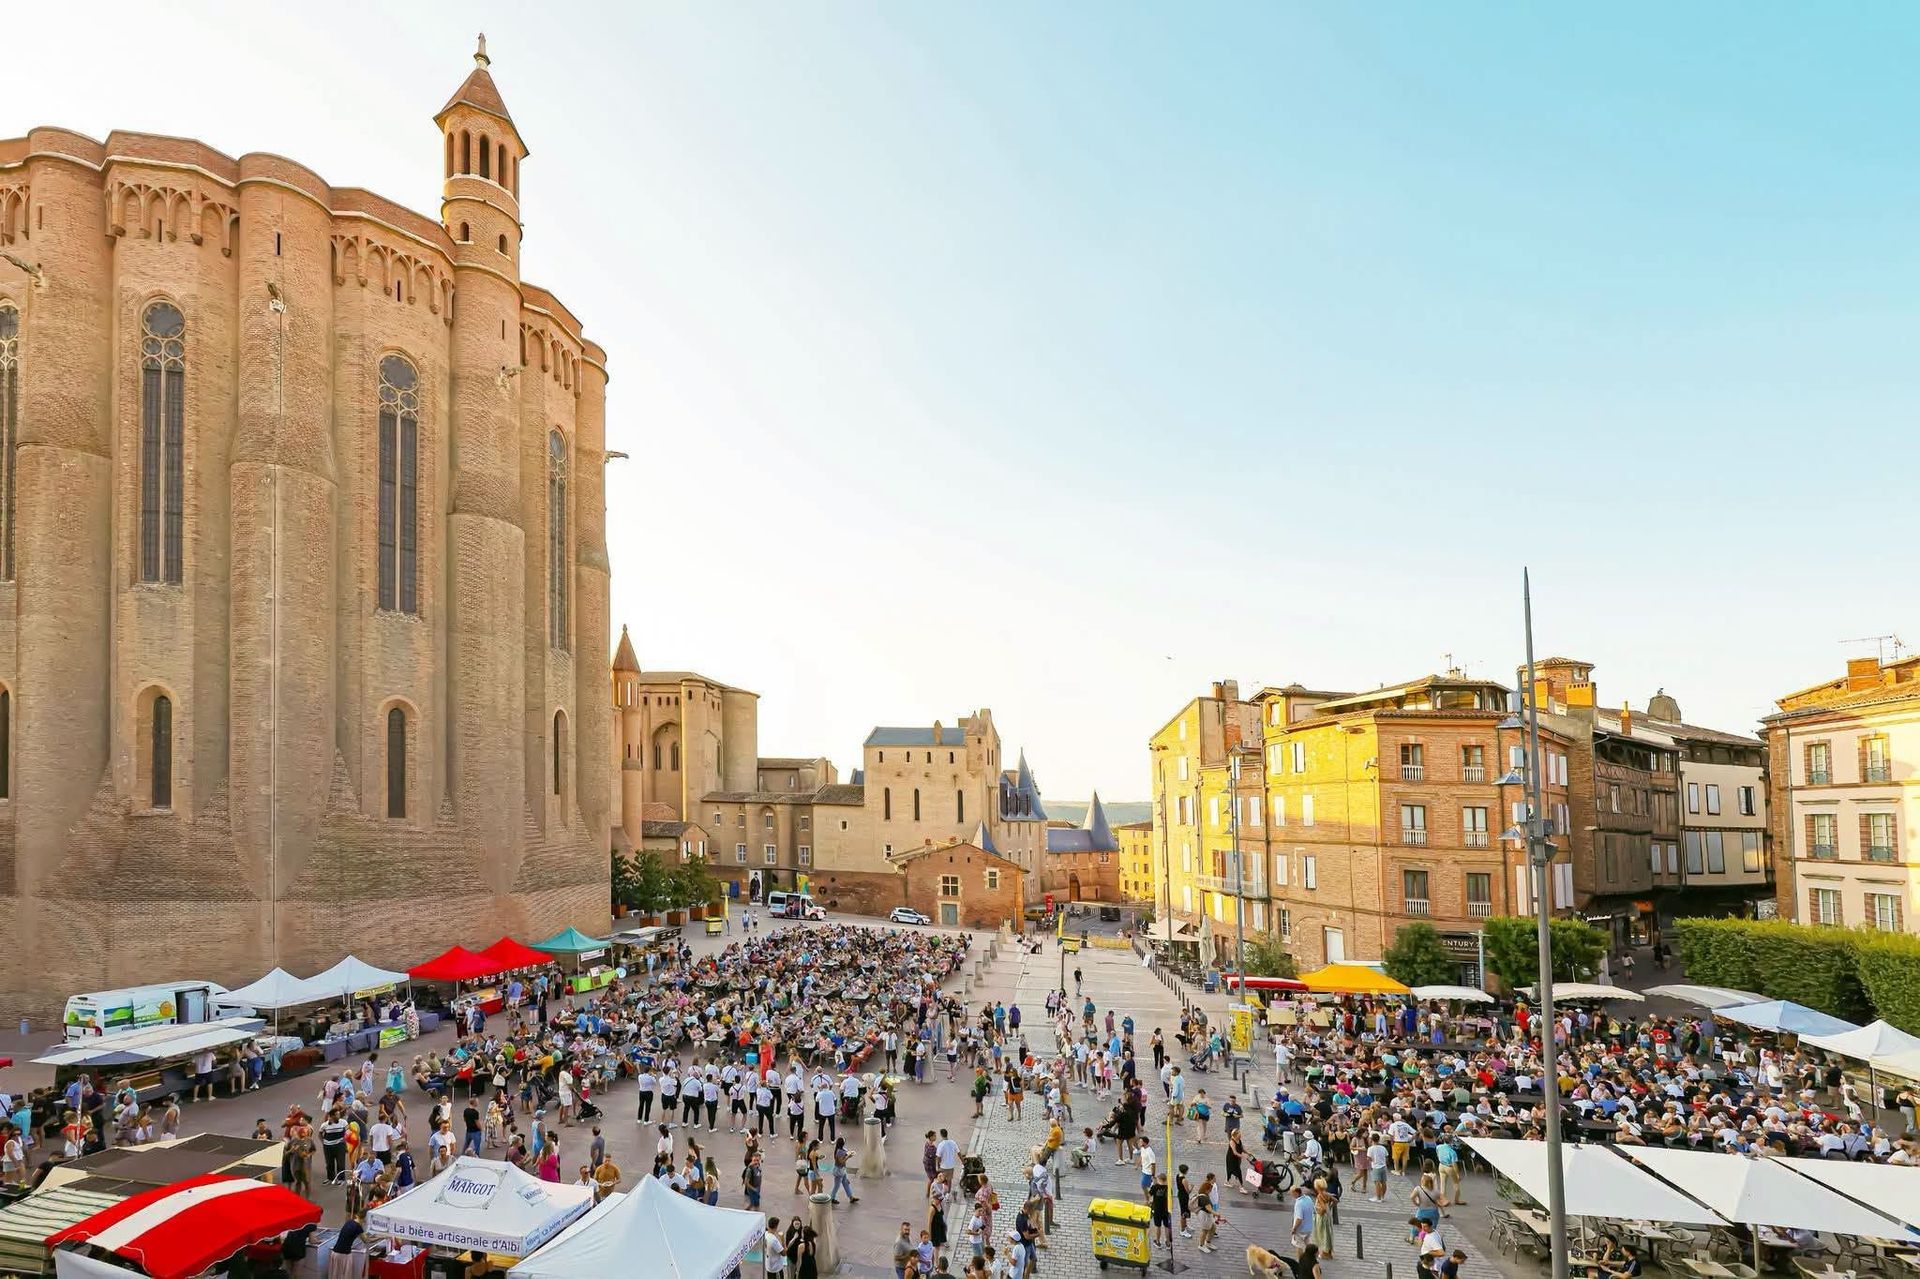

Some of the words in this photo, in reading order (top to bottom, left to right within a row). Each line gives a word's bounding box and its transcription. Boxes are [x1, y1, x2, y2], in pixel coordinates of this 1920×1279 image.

[447, 1179, 496, 1196] MARGOT
[393, 1222, 405, 1234] La
[408, 1224, 434, 1239] bière
[437, 1231, 489, 1248] artisanale
[491, 1239, 520, 1253] d'Albi
